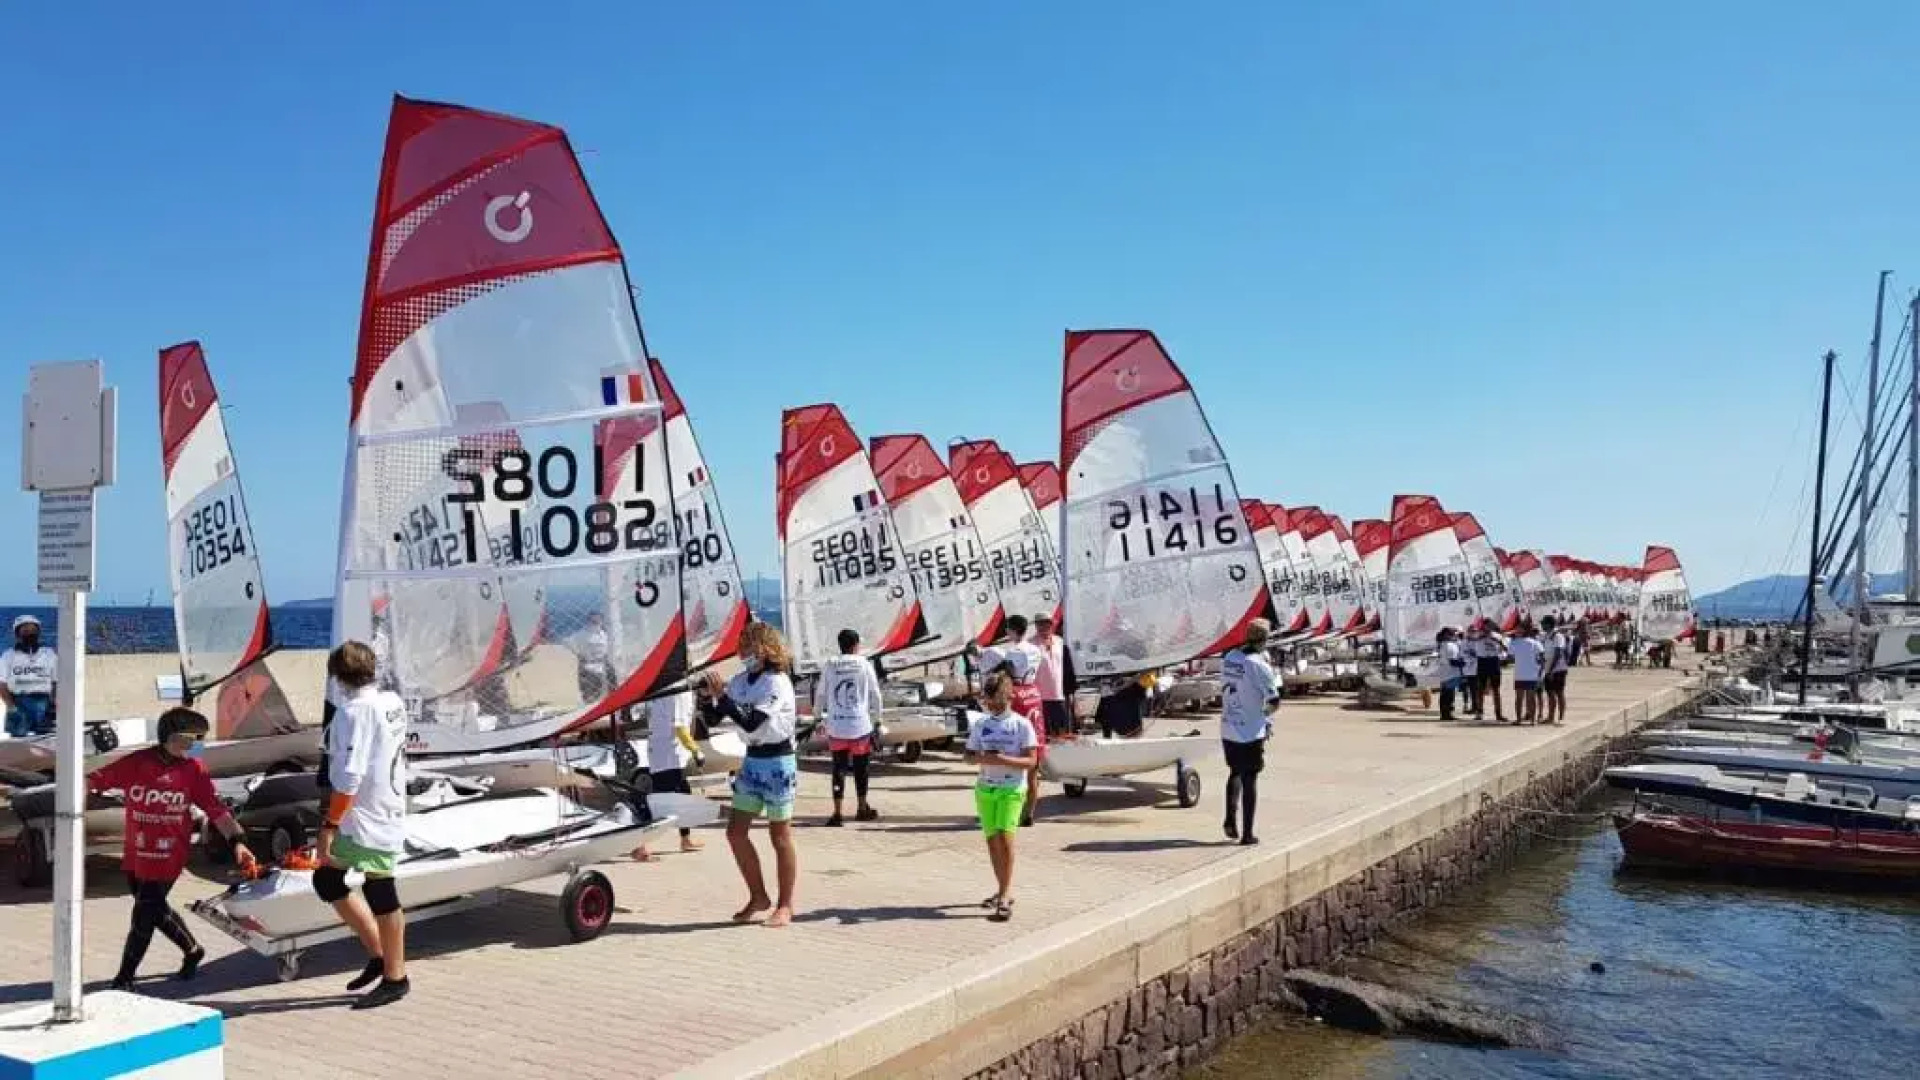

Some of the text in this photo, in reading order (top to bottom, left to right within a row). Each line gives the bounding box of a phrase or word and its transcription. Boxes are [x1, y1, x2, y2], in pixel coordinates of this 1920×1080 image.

[190, 527, 245, 578] 10354
[464, 500, 656, 562] 11082
[1121, 513, 1237, 561] 11416
[819, 547, 896, 587] 11035
